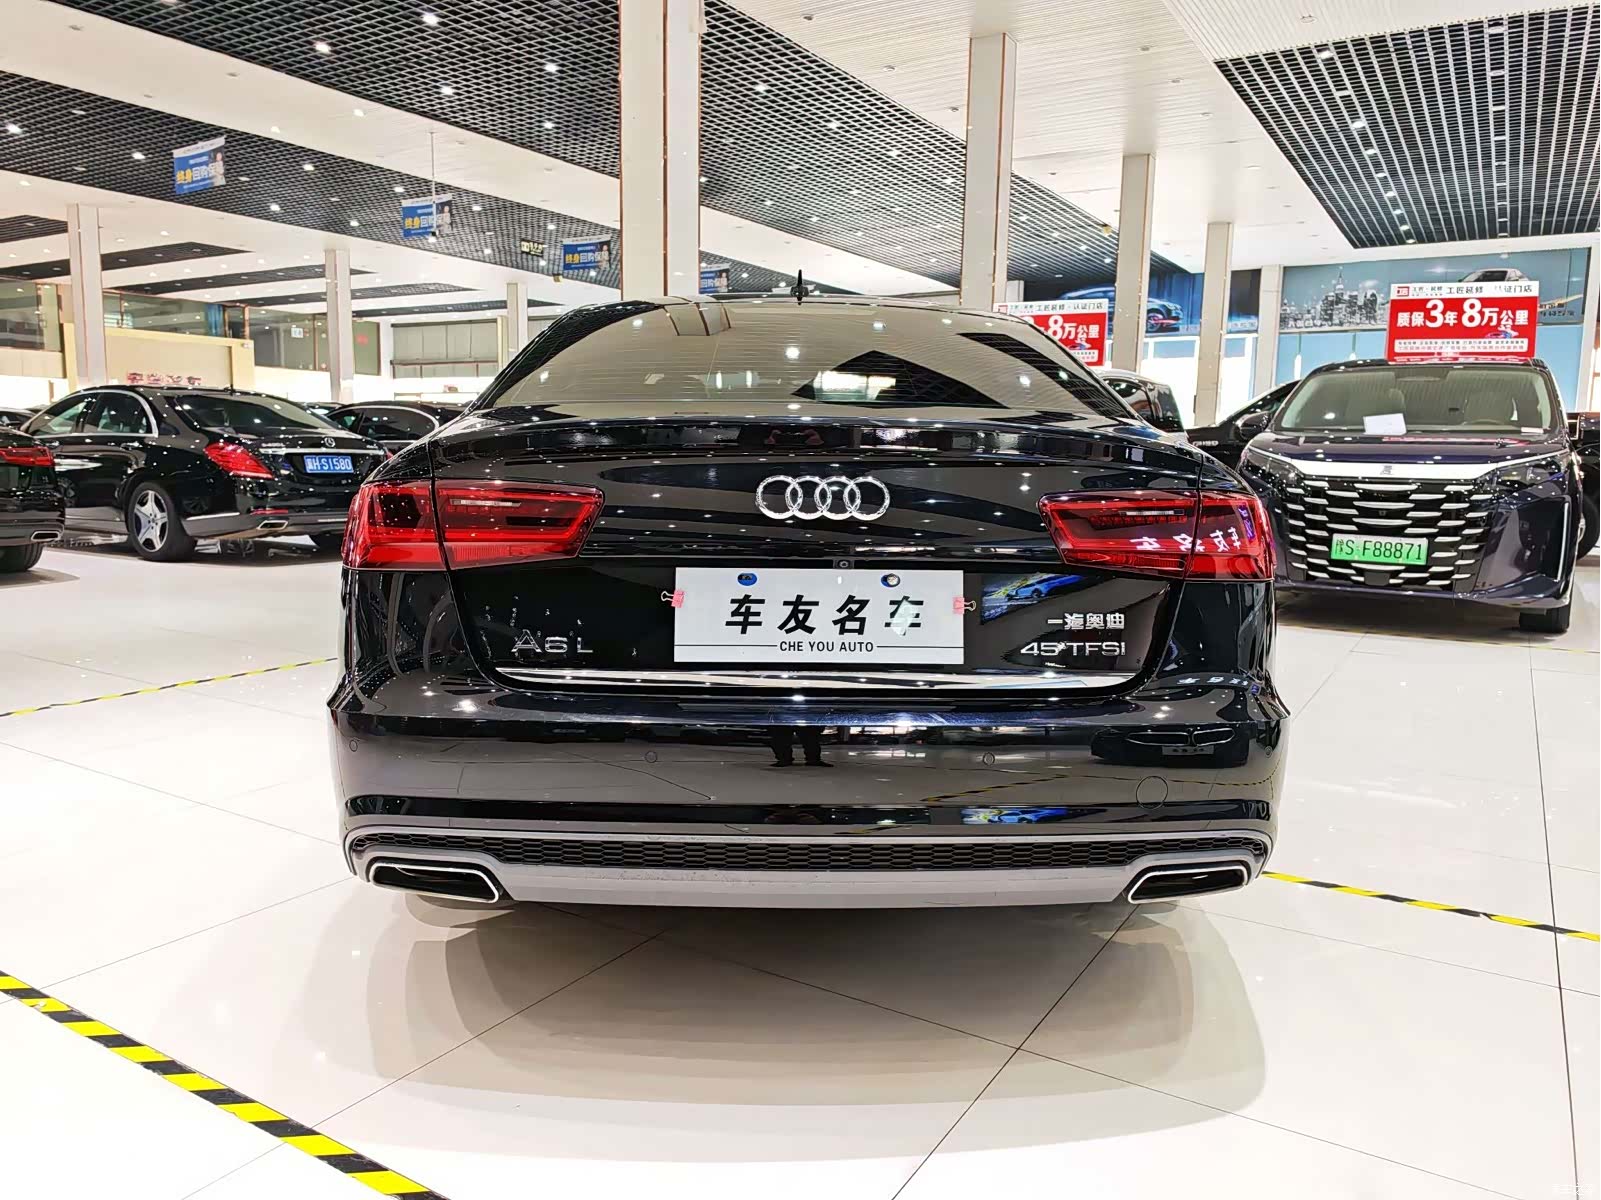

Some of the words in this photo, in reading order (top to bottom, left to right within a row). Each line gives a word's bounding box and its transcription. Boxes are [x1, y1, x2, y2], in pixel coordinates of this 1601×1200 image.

[725, 594, 925, 636] 车友名车
[779, 641, 804, 652] CHE
[808, 641, 835, 653] YOU
[839, 641, 875, 653] AUTO
